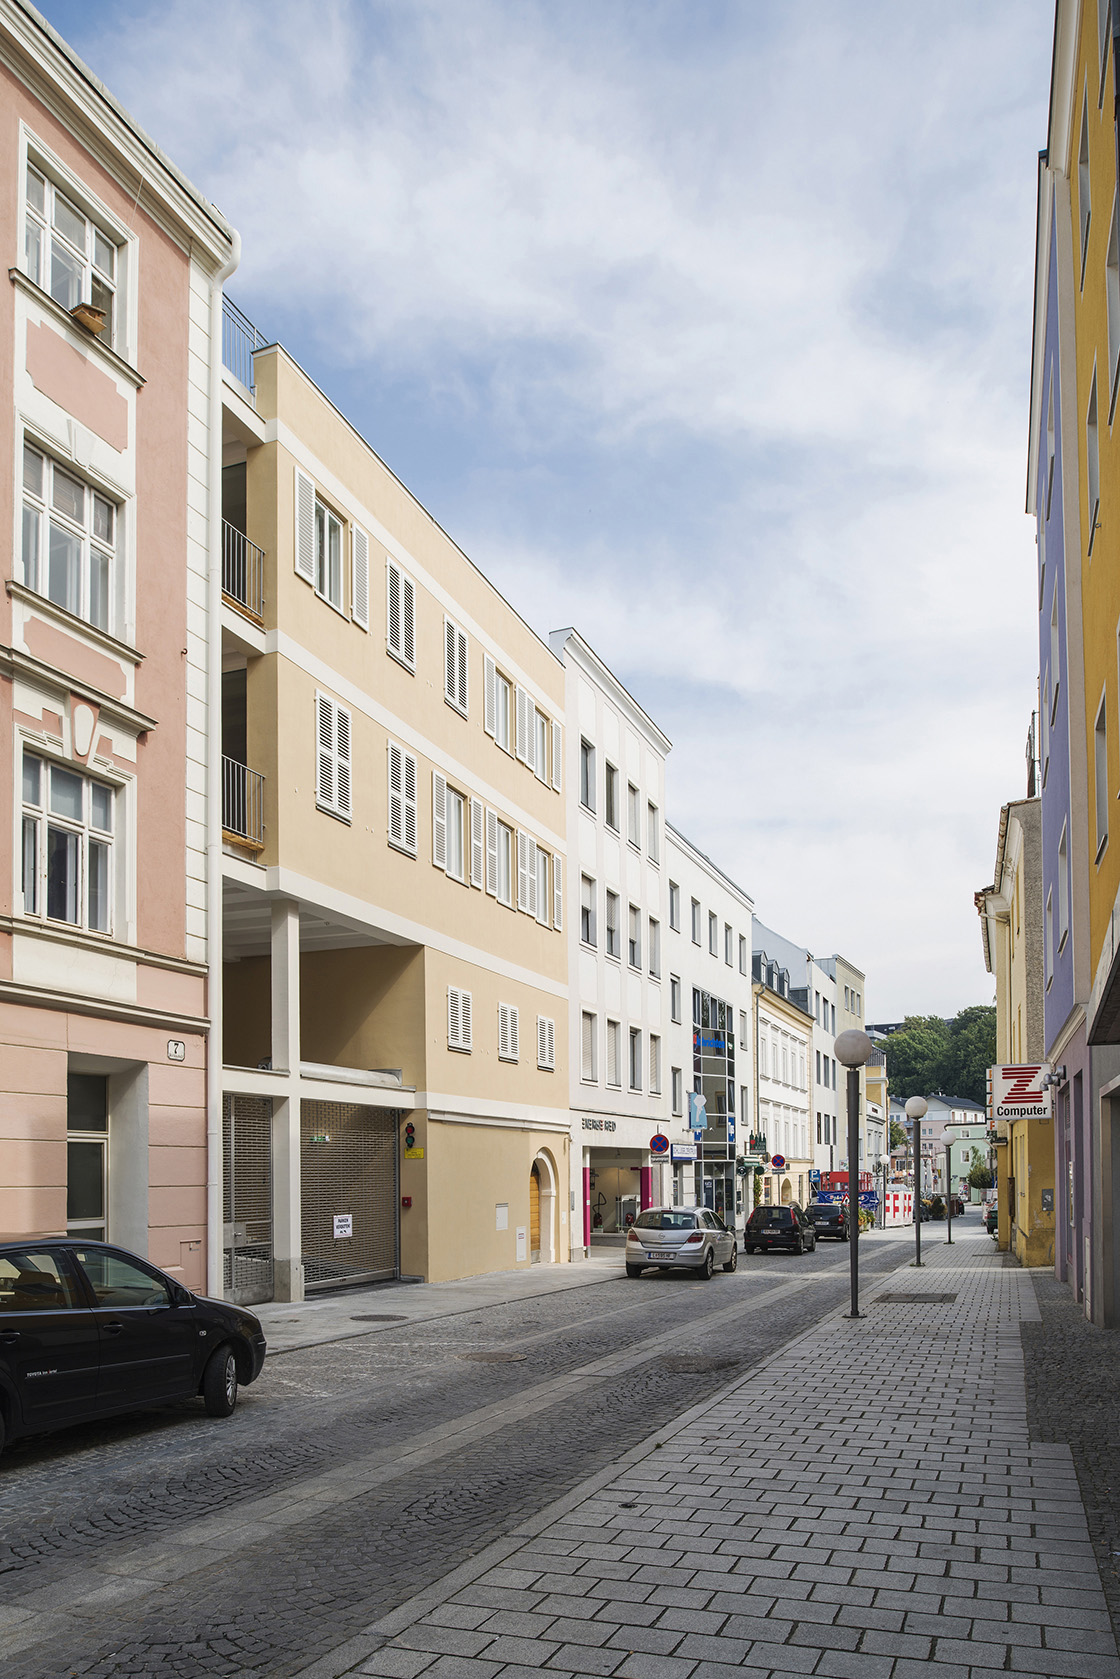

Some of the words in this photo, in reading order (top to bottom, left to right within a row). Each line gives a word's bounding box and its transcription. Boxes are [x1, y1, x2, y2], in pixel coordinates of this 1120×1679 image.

[174, 1042, 179, 1054] 7
[997, 1105, 1048, 1117] Computer
[811, 1170, 818, 1180] P
